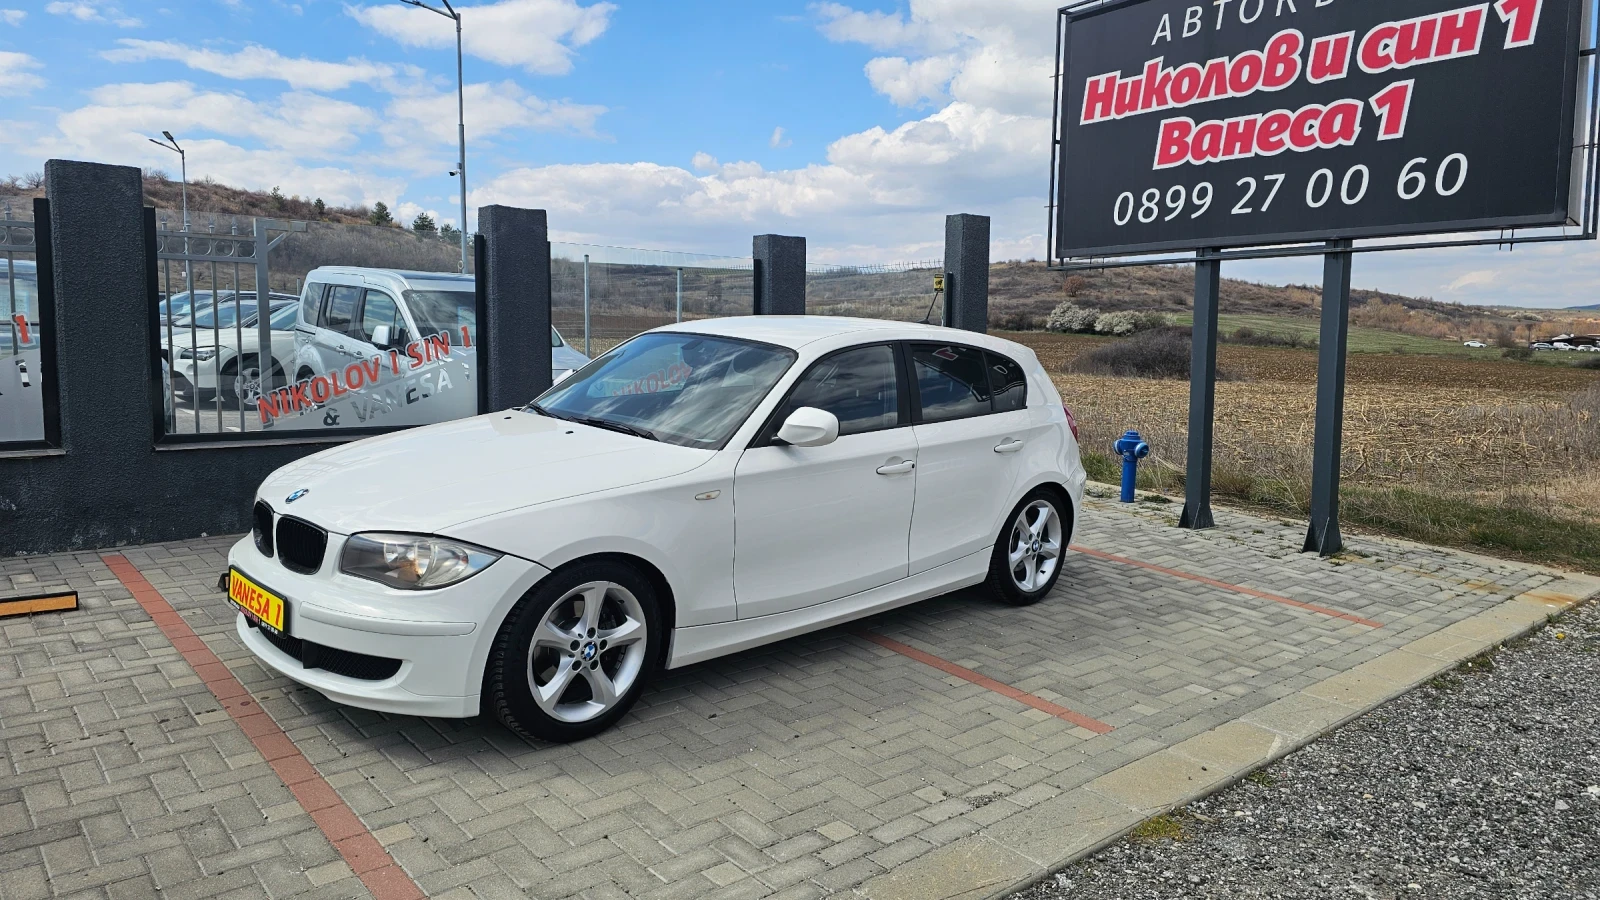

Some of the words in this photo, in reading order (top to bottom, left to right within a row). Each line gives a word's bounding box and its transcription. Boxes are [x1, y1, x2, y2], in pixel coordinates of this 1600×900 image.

[1151, 0, 1335, 46] АВТОК
[1079, 29, 1304, 126] Николов
[1307, 30, 1356, 84] и
[1357, 3, 1489, 74] син
[1495, 0, 1542, 49] 1
[1152, 99, 1364, 170] Ванеса
[1370, 79, 1414, 141] 1
[1113, 181, 1213, 226] 0899
[1230, 173, 1286, 215] 27
[1305, 164, 1369, 209] 00
[1398, 152, 1469, 200] 60
[257, 354, 382, 427] NIKOLOV
[388, 348, 400, 376] I
[405, 330, 451, 370] SIN
[460, 325, 474, 349] 1
[323, 407, 340, 427] &
[351, 368, 453, 423] VANESA
[232, 575, 270, 620] VANESA
[275, 603, 282, 627] 1
